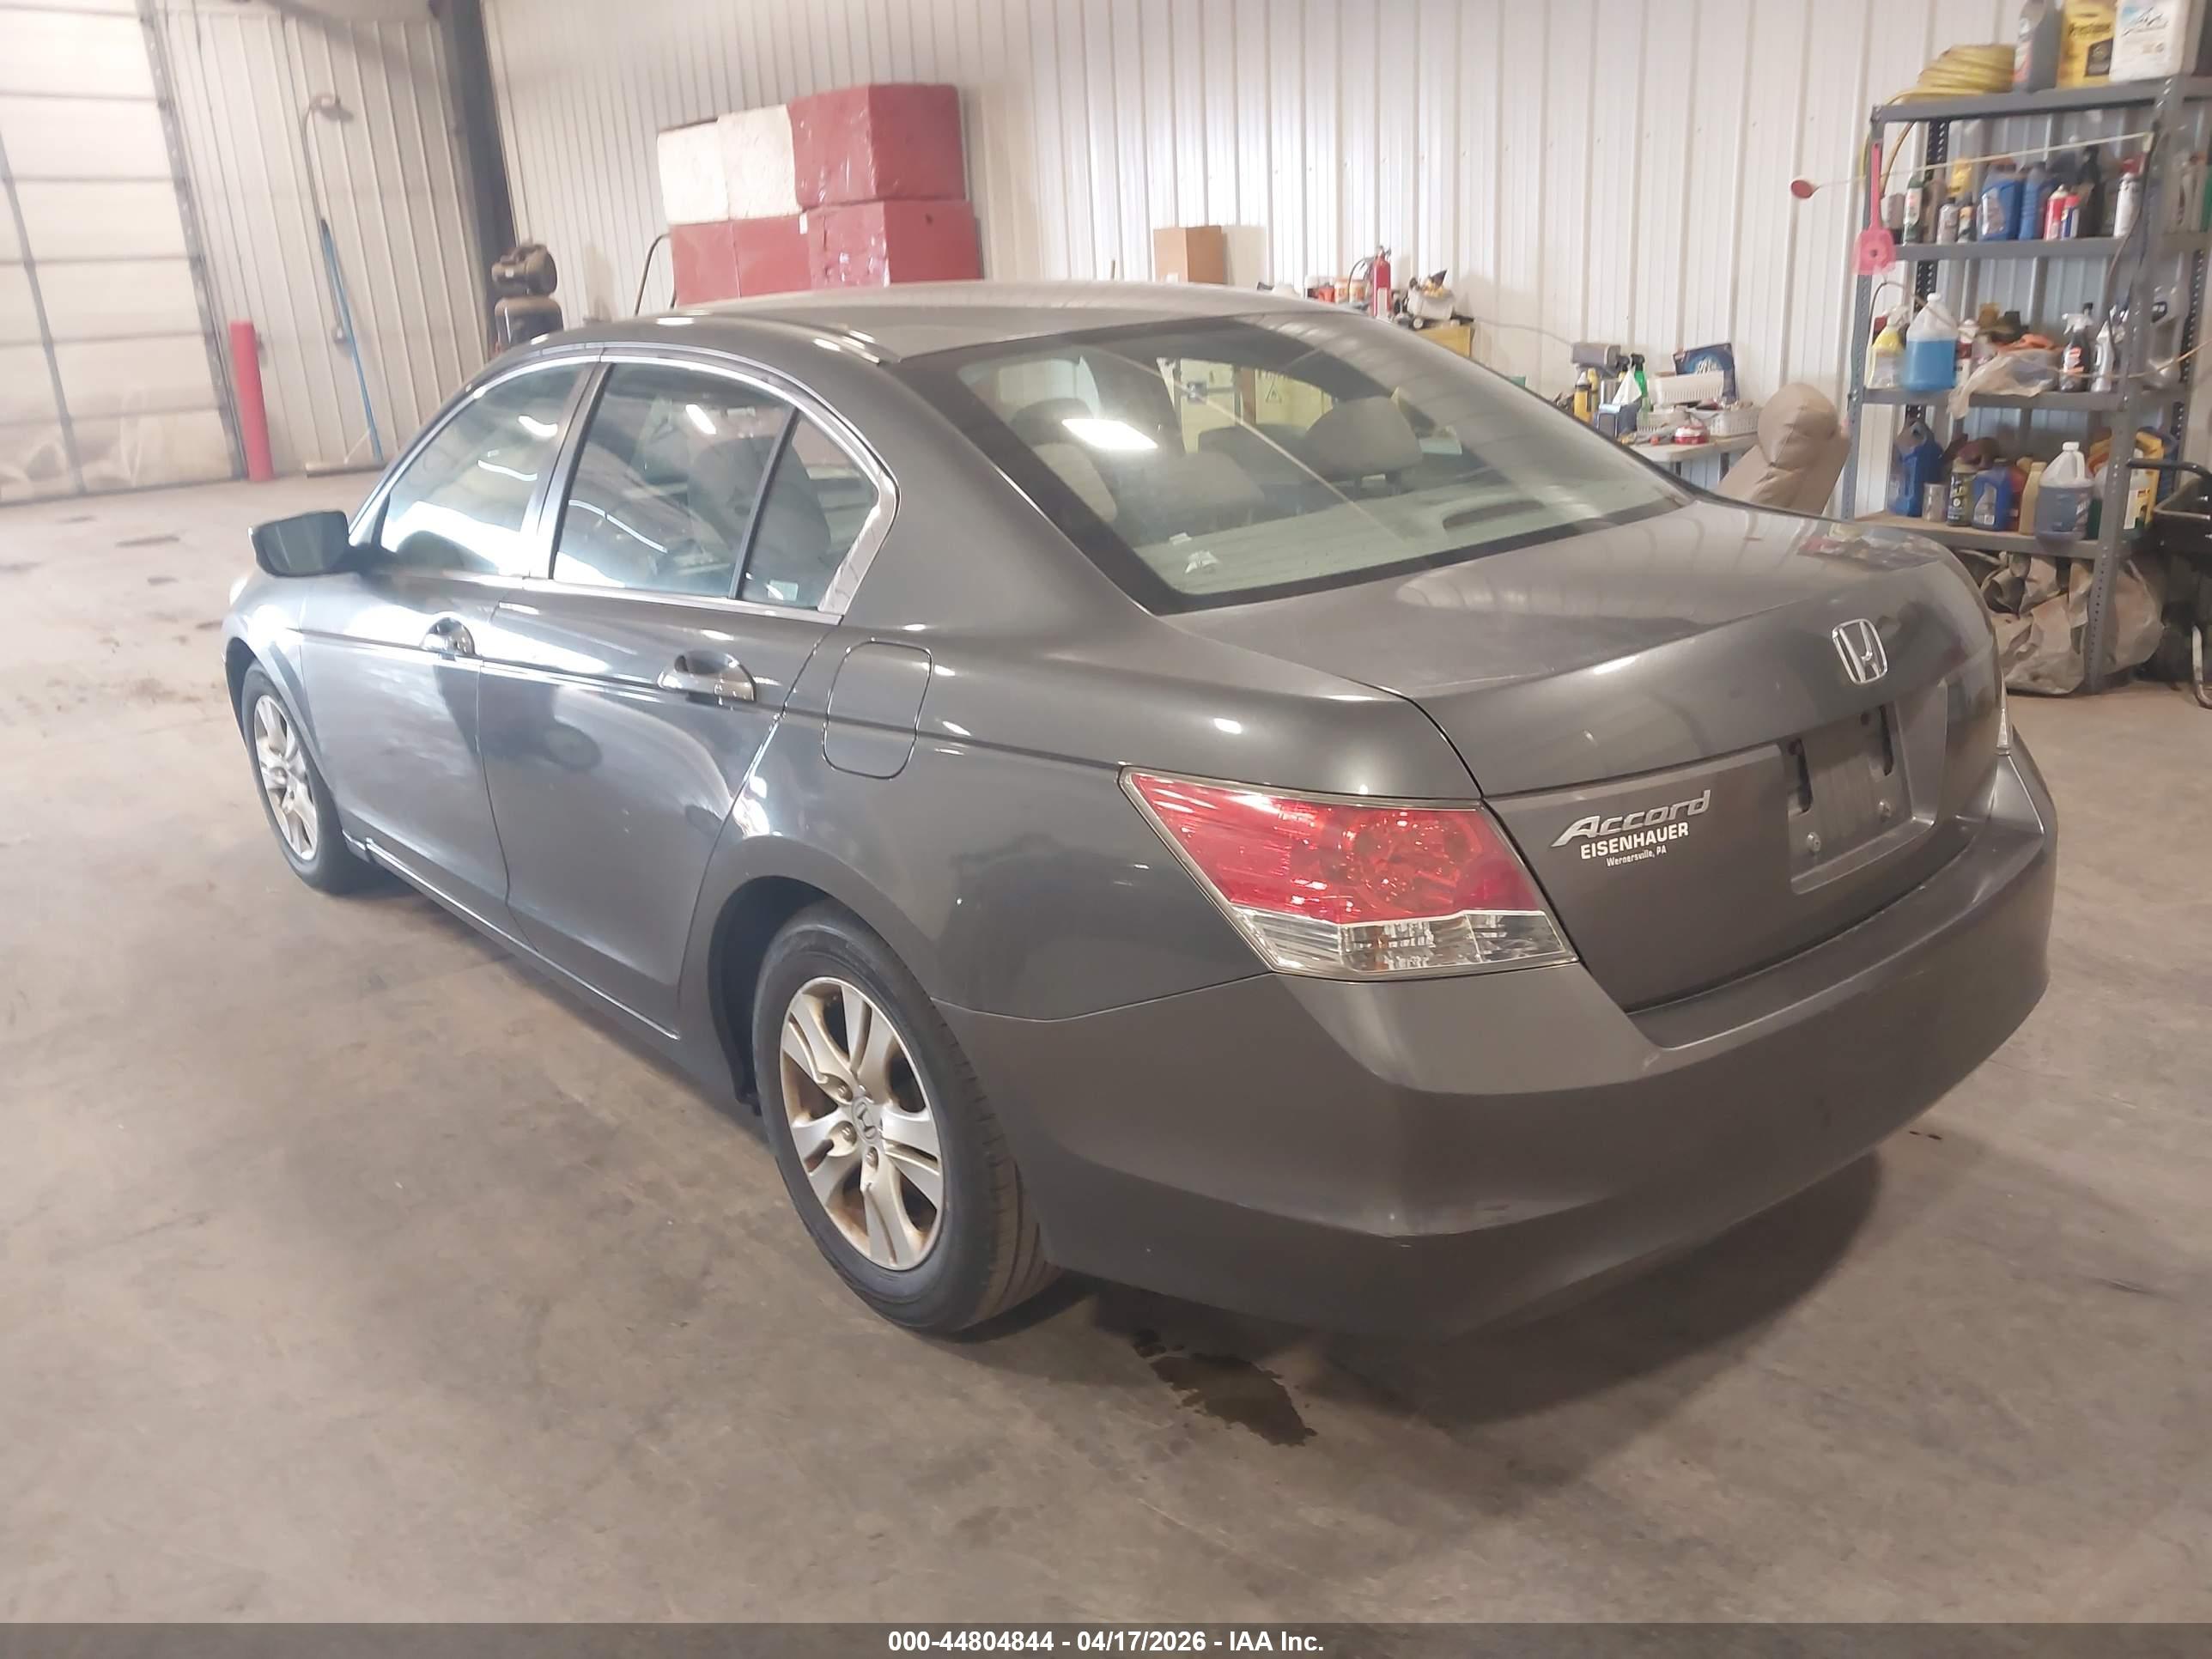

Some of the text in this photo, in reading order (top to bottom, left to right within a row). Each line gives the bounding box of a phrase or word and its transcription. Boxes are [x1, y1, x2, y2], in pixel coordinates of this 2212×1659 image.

[1550, 789, 1711, 848] Accord
[1580, 822, 1689, 860] EISENHAUER
[1656, 844, 1668, 857] PA
